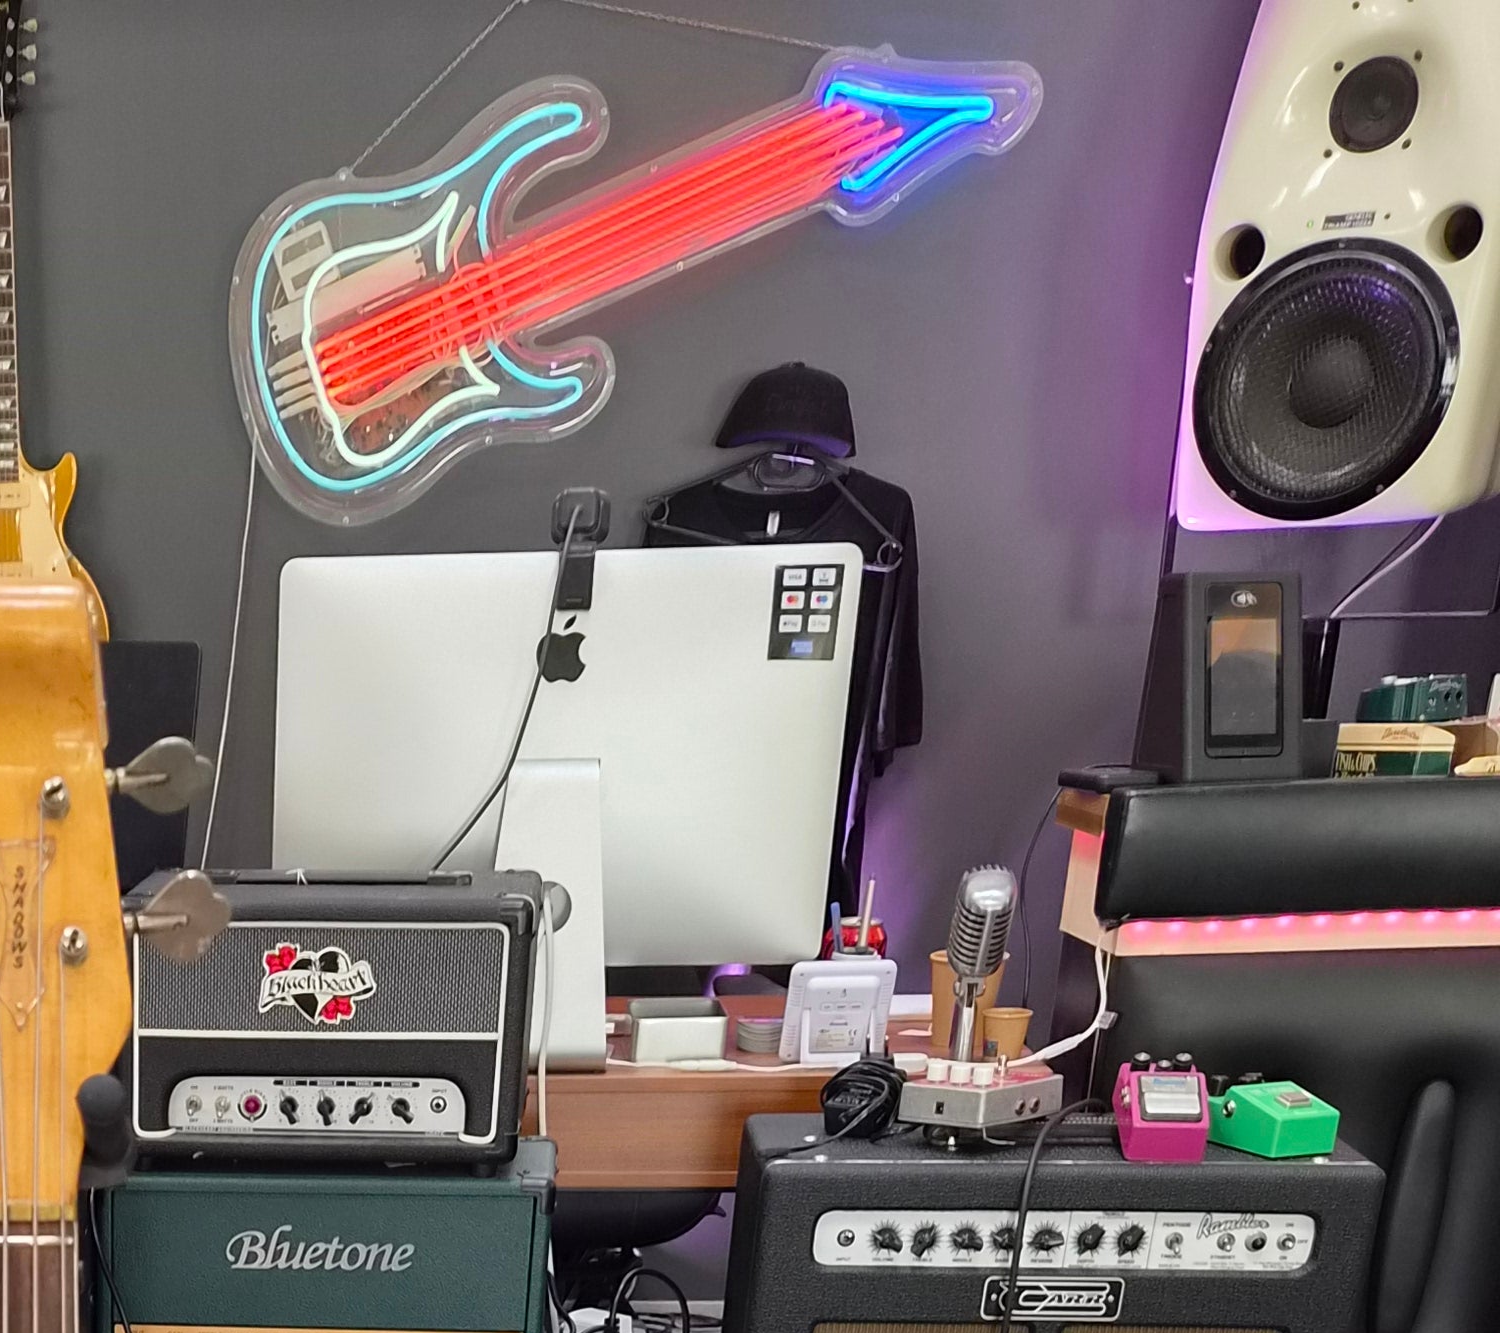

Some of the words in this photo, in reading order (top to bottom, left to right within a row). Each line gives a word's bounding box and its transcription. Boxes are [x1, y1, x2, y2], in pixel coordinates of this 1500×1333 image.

[12, 865, 27, 969] SHADOWS
[268, 970, 368, 998] Blackheart
[226, 1224, 416, 1273] Bluetone
